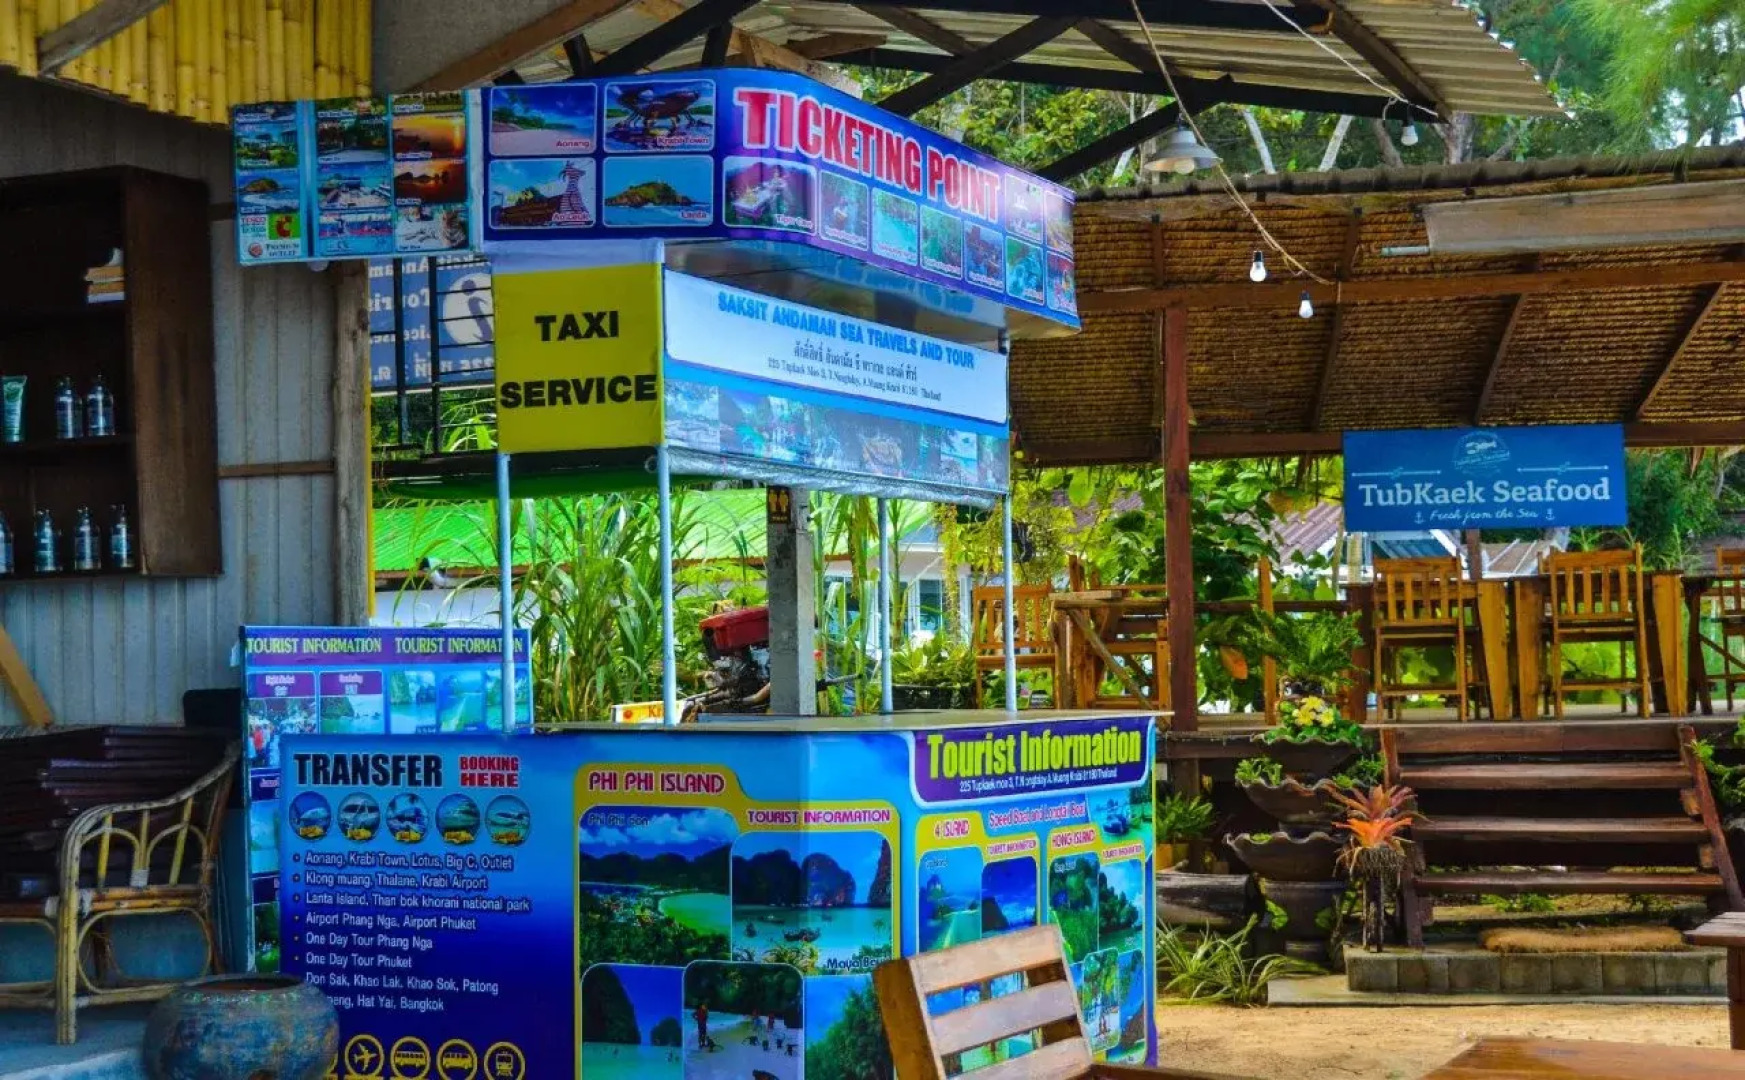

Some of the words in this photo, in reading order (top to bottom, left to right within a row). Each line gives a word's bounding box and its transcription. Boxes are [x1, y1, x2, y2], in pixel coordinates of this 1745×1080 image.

[734, 88, 922, 195] TICKETING
[927, 146, 1001, 223] POINT
[534, 310, 619, 341] TAXI
[718, 291, 768, 321] SAKSIT
[773, 305, 836, 337] ANDAMAN
[840, 322, 863, 344] SEA
[867, 328, 918, 355] TRAVELS
[920, 341, 942, 361] AND
[945, 347, 974, 369] TOUR
[500, 374, 657, 408] SERVICE
[1358, 480, 1485, 506] TubKaek
[1493, 476, 1611, 503] Seafood
[1430, 509, 1461, 521] Fresh
[1461, 511, 1492, 525] from
[1495, 507, 1513, 519] the
[1516, 508, 1538, 518] Sea
[247, 637, 299, 654] TOURIST
[302, 637, 382, 654] INFORMATION
[395, 637, 443, 653] TOURIST
[448, 637, 523, 653] INFORMATN
[927, 732, 1016, 779] Tourist
[1020, 726, 1141, 773] Information
[294, 753, 443, 788] TRANSFER
[459, 756, 519, 772] BOOKING
[460, 772, 519, 788] HERE
[588, 770, 618, 792] PHI
[624, 771, 654, 793] PHI
[659, 772, 726, 795] ISLAND
[588, 813, 605, 825] Phi
[608, 813, 625, 826] Phi
[748, 809, 799, 824] TOURIST
[803, 808, 891, 824] INFORMATION
[306, 851, 345, 867] Aonang,
[349, 852, 375, 866] Krabi
[378, 853, 409, 867] Town,
[412, 854, 443, 868] Lotus,
[446, 855, 463, 870] Big
[467, 856, 478, 868] C,
[482, 855, 513, 869] Outlet
[306, 871, 334, 886] Klong
[377, 873, 418, 887] Thalane,
[422, 874, 448, 887] Krabi
[452, 876, 487, 890] Airport
[306, 892, 333, 904] Lanta
[336, 892, 369, 906] Island,
[372, 893, 396, 906] Than
[400, 894, 419, 907] bok
[422, 896, 459, 908] khorani
[462, 897, 502, 910] national
[506, 898, 530, 912] park
[306, 912, 338, 926] Airport
[343, 913, 373, 929] Phang
[403, 915, 437, 930] Airport
[441, 916, 476, 930] Phuket
[306, 932, 326, 944] One
[329, 932, 348, 948] Day
[351, 933, 375, 946] Tour
[377, 934, 409, 950] Phang
[413, 935, 433, 951] Nga
[306, 952, 326, 965] One
[329, 952, 348, 968] Day
[351, 953, 375, 966] Tour
[377, 955, 412, 968] Phuket
[826, 957, 860, 971] Maya
[306, 972, 326, 985] Don
[329, 973, 350, 987] Sak,
[353, 975, 379, 987] Khao
[407, 976, 433, 990] Khao
[437, 978, 459, 991] Sok,
[463, 979, 499, 995] Patong
[357, 994, 375, 1007] Hat
[379, 996, 396, 1009] Yai,
[400, 997, 444, 1013] Bangkok
